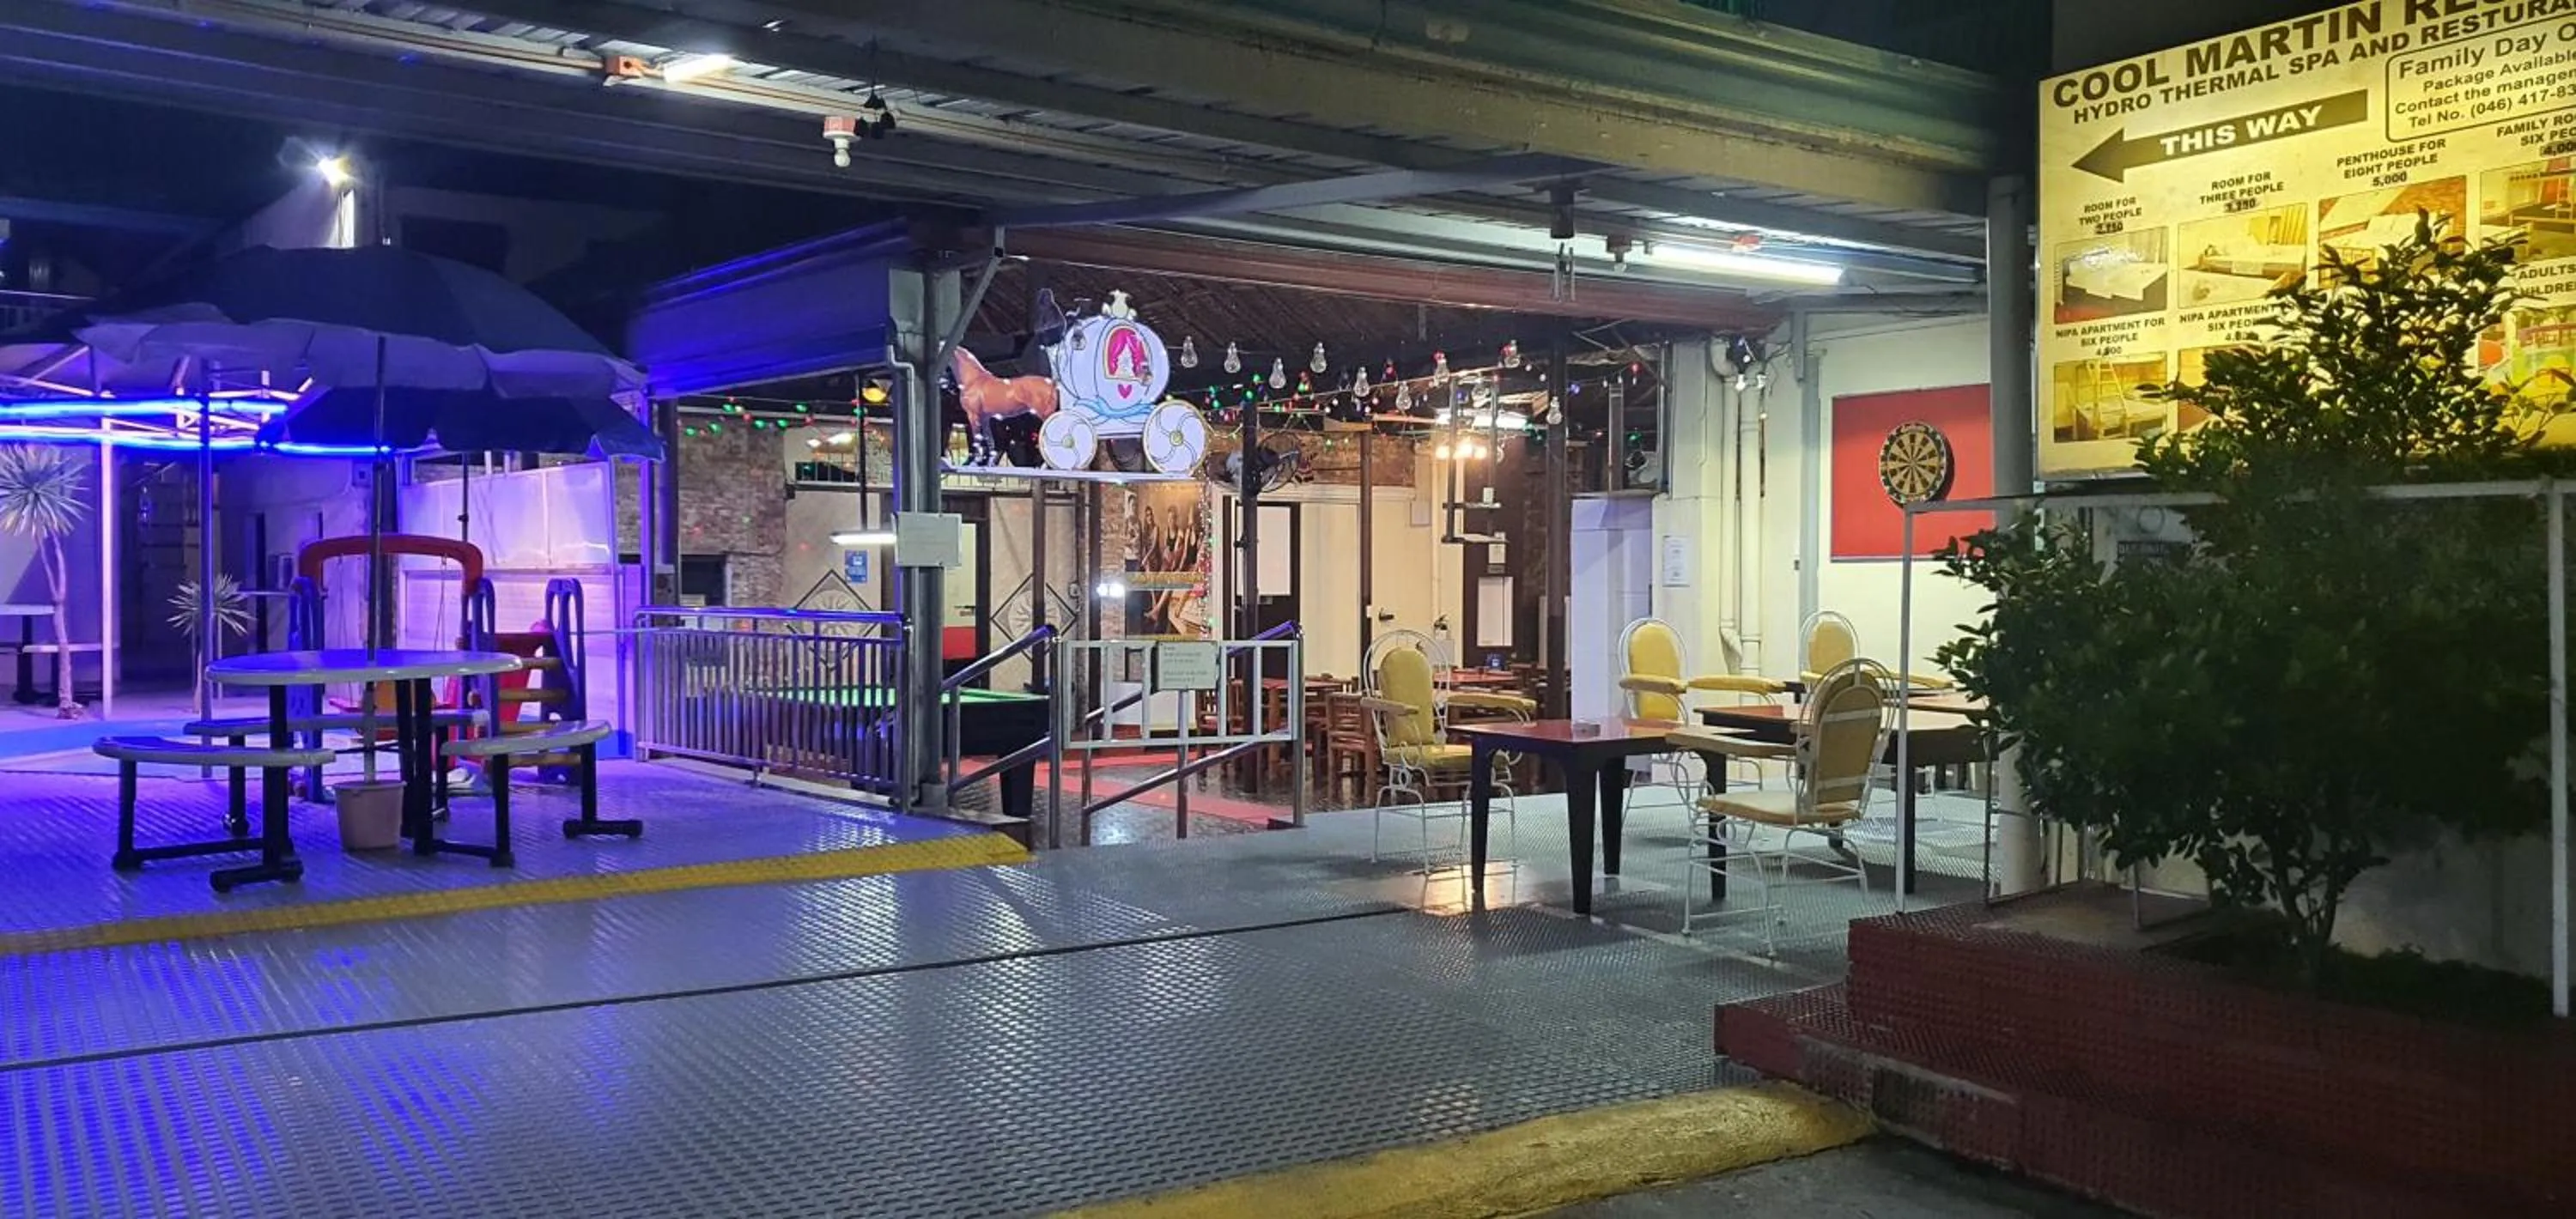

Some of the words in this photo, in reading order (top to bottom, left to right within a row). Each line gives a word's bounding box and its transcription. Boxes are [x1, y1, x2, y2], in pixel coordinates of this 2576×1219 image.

[2053, 58, 2170, 107] COOL
[2186, 1, 2381, 78] MARTIN
[2074, 94, 2152, 124] HYDRO
[2160, 64, 2280, 104] THERMAL
[2289, 50, 2340, 76] SPA
[2349, 33, 2409, 61] AND
[2421, 0, 2576, 45] RESTURA
[2400, 45, 2486, 79] Family
[2495, 33, 2547, 58] Day
[2423, 68, 2494, 93] Package
[2396, 92, 2460, 115] Contact
[2464, 85, 2491, 102] the
[2408, 114, 2432, 129] Tel
[2437, 109, 2465, 123] No.
[2470, 96, 2512, 119] (046)
[2497, 118, 2548, 137] FAMILY
[2554, 111, 2576, 126] RO
[2160, 125, 2237, 156] THIS
[2246, 106, 2324, 139] WAY
[2520, 132, 2544, 146] SIX
[2336, 144, 2415, 168] PENTHOUSE
[2419, 138, 2445, 152] FOR
[2343, 162, 2382, 179] EIGHT
[2387, 153, 2438, 172] PEOPLE
[2212, 177, 2245, 191] ROOM
[2248, 171, 2271, 185] FOR
[2372, 171, 2407, 186] 5,000
[2200, 189, 2235, 205] THREE
[2239, 182, 2284, 198] PEOPLE
[2079, 215, 2100, 226] TWO
[2104, 207, 2142, 222] PEOPLE
[2084, 201, 2114, 214] ROOM
[2116, 197, 2136, 208] FOR
[2513, 281, 2576, 296] HILDRE
[2179, 312, 2204, 324] NIPA
[2208, 304, 2275, 318] APARTMENT
[2208, 320, 2226, 331] SIX
[2056, 327, 2079, 338] NIPA
[2081, 321, 2141, 335] APARTMENT
[2144, 317, 2165, 328] FOR
[2081, 337, 2097, 347] SIX
[2099, 332, 2138, 344] PEOPLE
